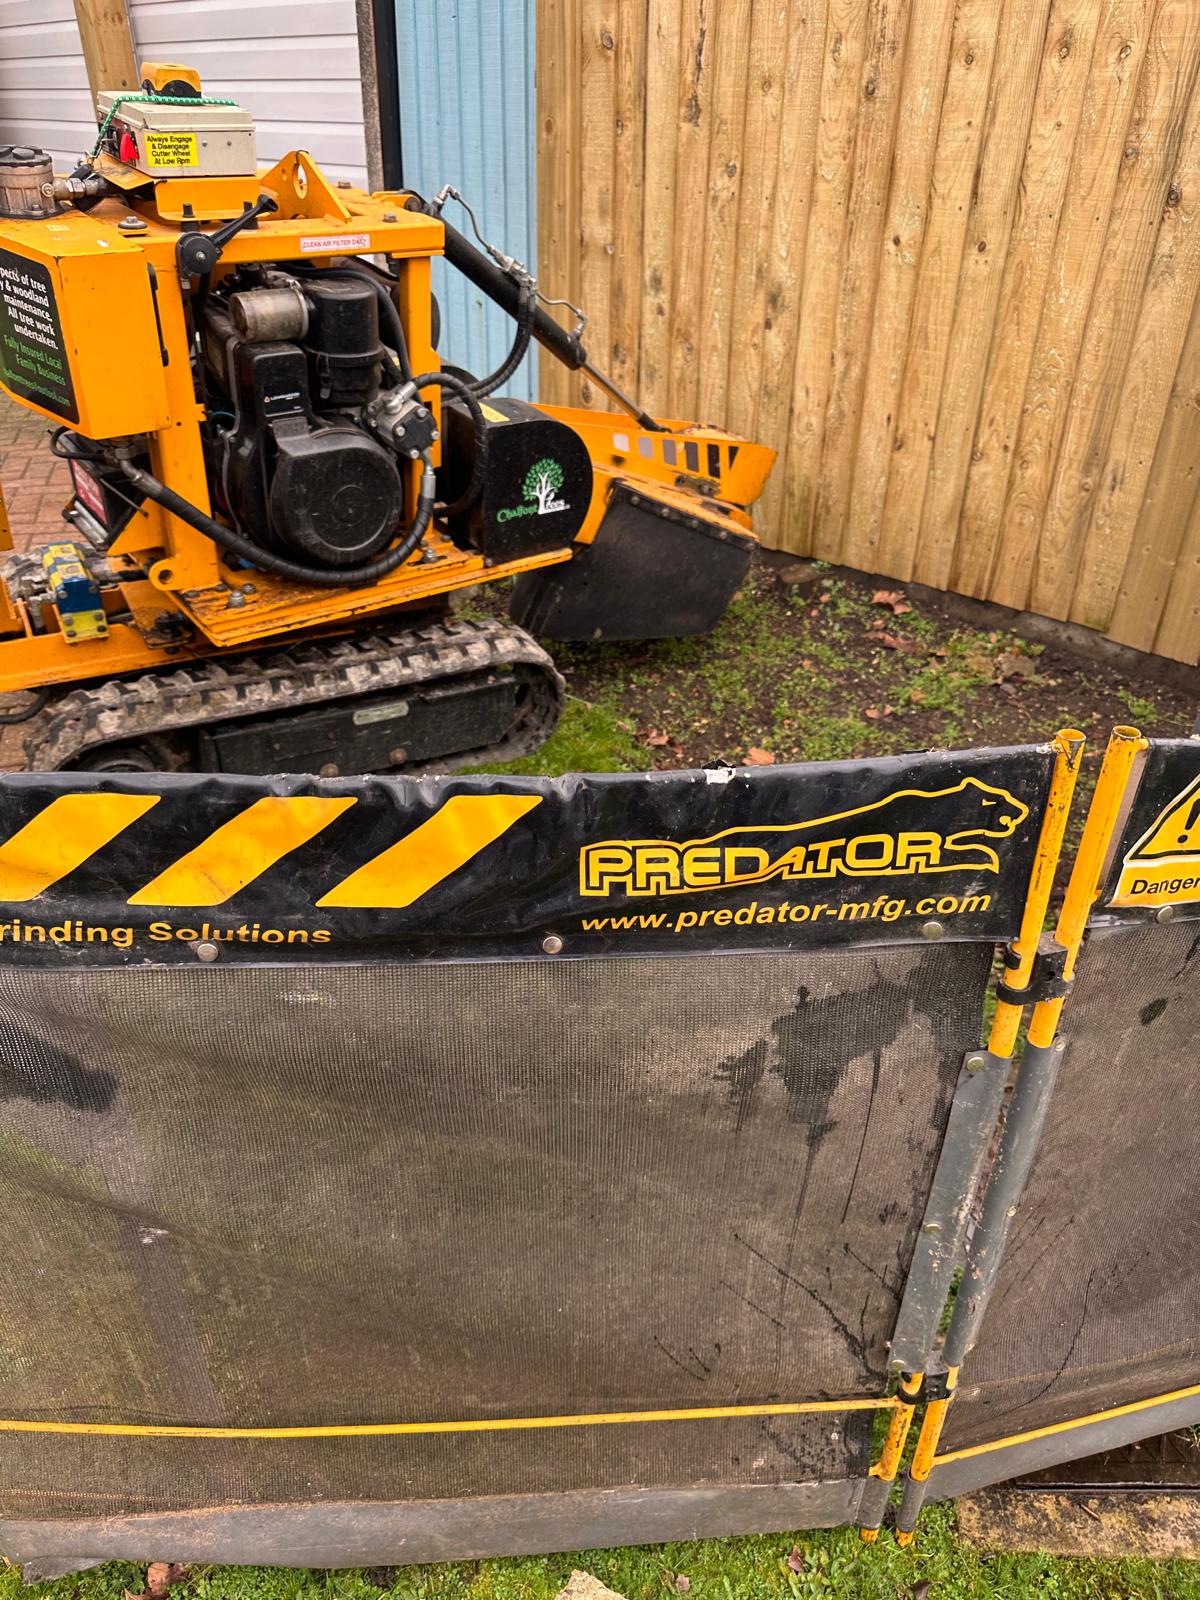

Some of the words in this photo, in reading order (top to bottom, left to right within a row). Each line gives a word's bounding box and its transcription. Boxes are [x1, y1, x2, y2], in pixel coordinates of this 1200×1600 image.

[5, 280, 11, 291] &
[12, 285, 49, 307] woodland
[21, 274, 29, 286] of
[31, 277, 46, 293] tree
[4, 293, 53, 322] maintenance.
[8, 306, 18, 320] All
[20, 312, 34, 328] tree
[36, 318, 55, 336] work
[4, 335, 19, 353] Fully
[14, 322, 58, 350] undertaken.
[16, 353, 36, 374] Family
[585, 831, 943, 892] PREDATOR
[1130, 876, 1200, 895] Danger
[581, 894, 991, 932] www.predator-mfg.com
[150, 922, 332, 944] Solutions
